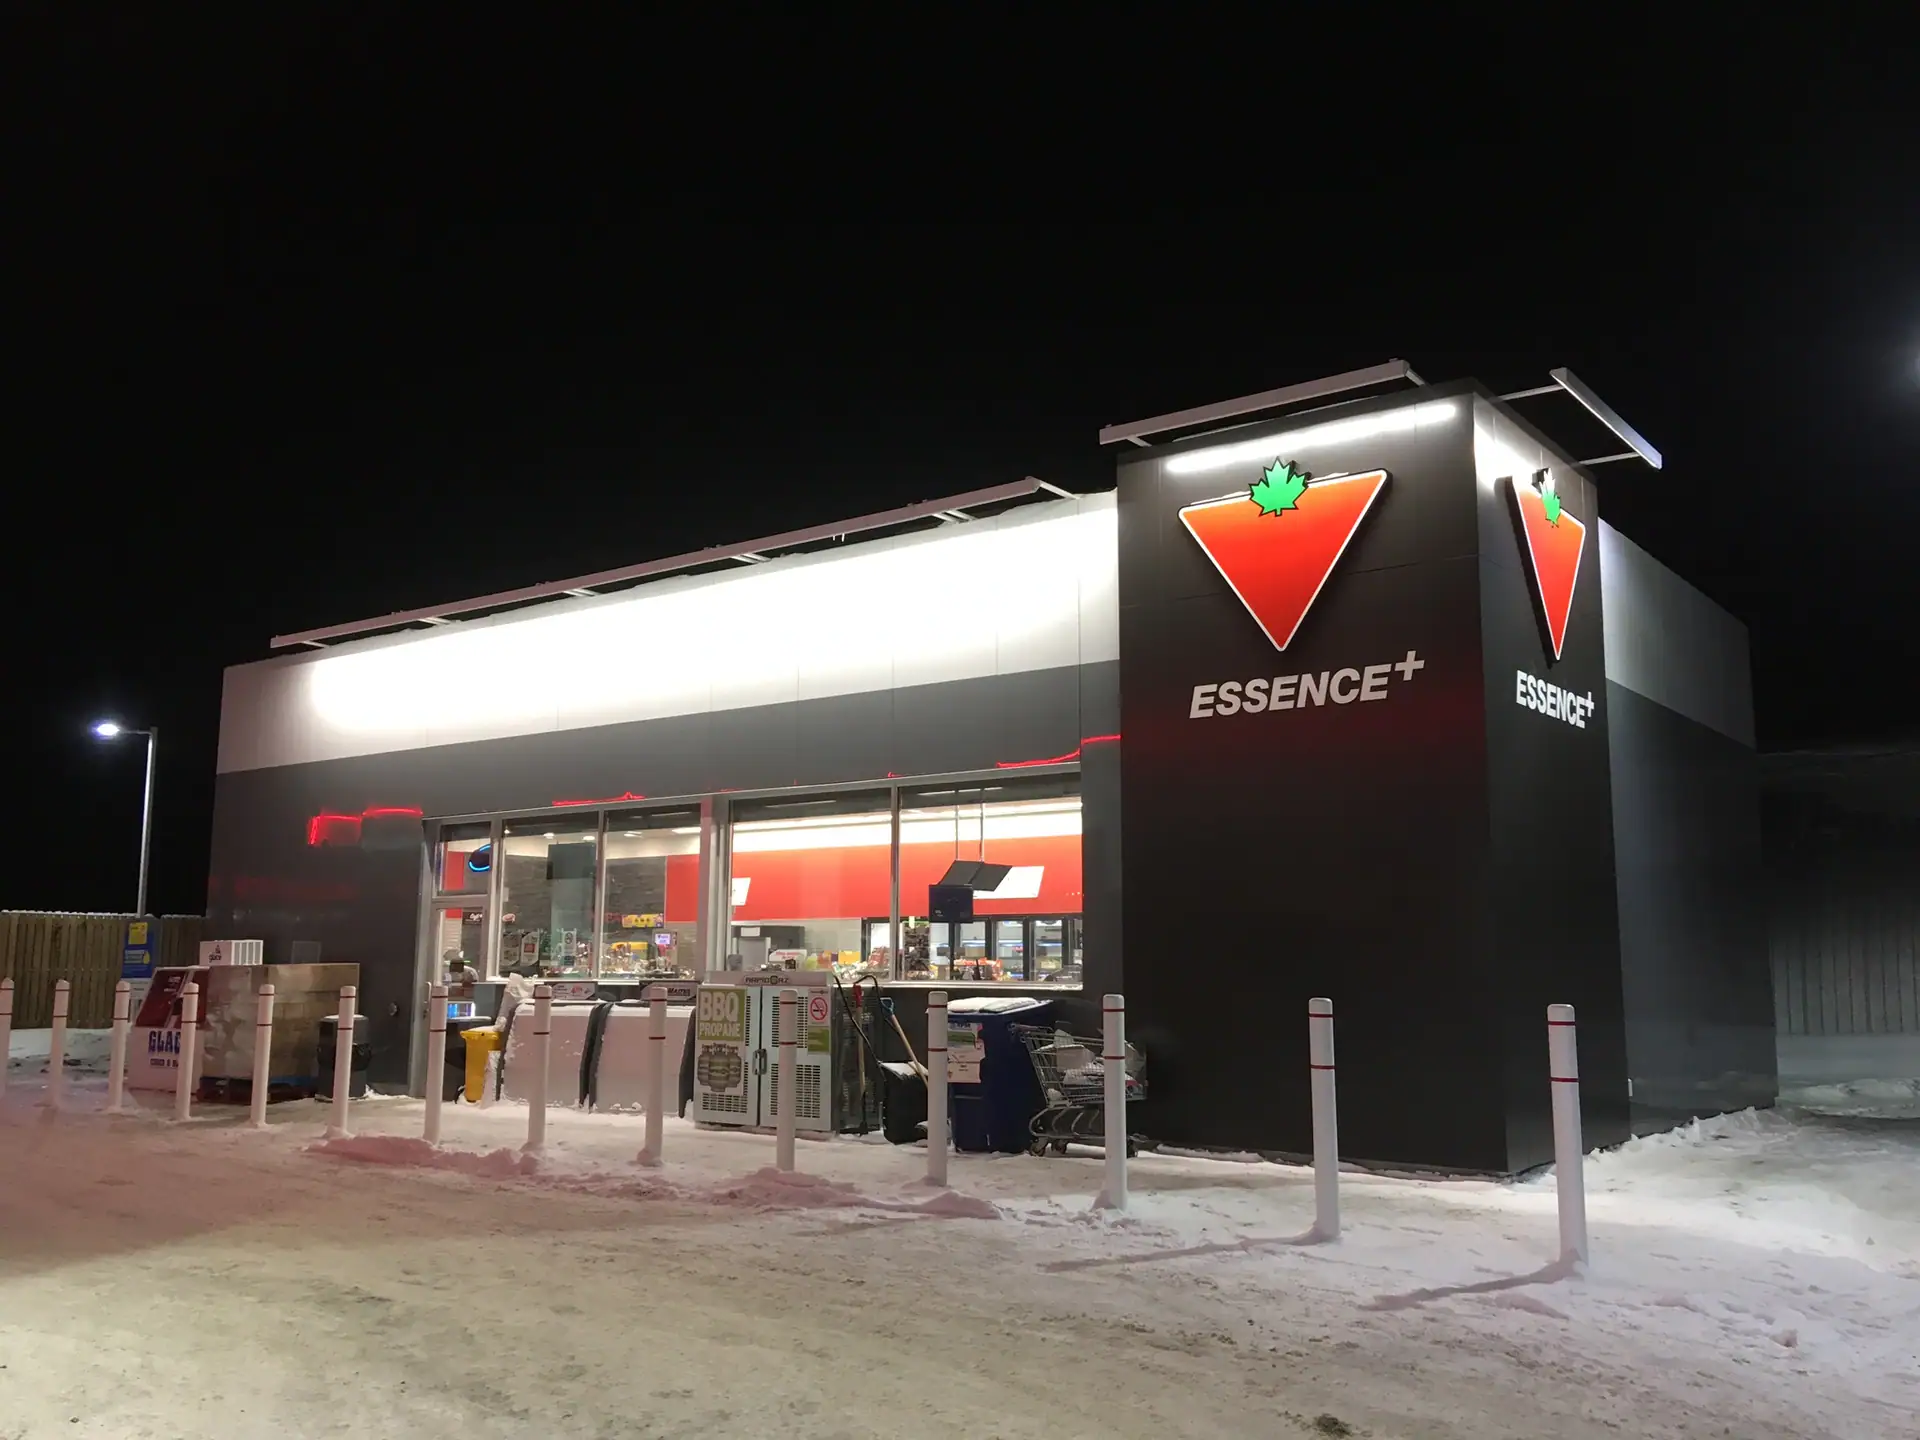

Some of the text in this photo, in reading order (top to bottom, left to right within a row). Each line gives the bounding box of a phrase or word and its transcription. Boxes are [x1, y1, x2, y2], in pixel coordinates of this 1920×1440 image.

[1189, 650, 1425, 719] ESSENCE+
[1516, 669, 1595, 729] ESSENCE+
[700, 991, 739, 1022] BBQ
[699, 1022, 741, 1038] PROPANE
